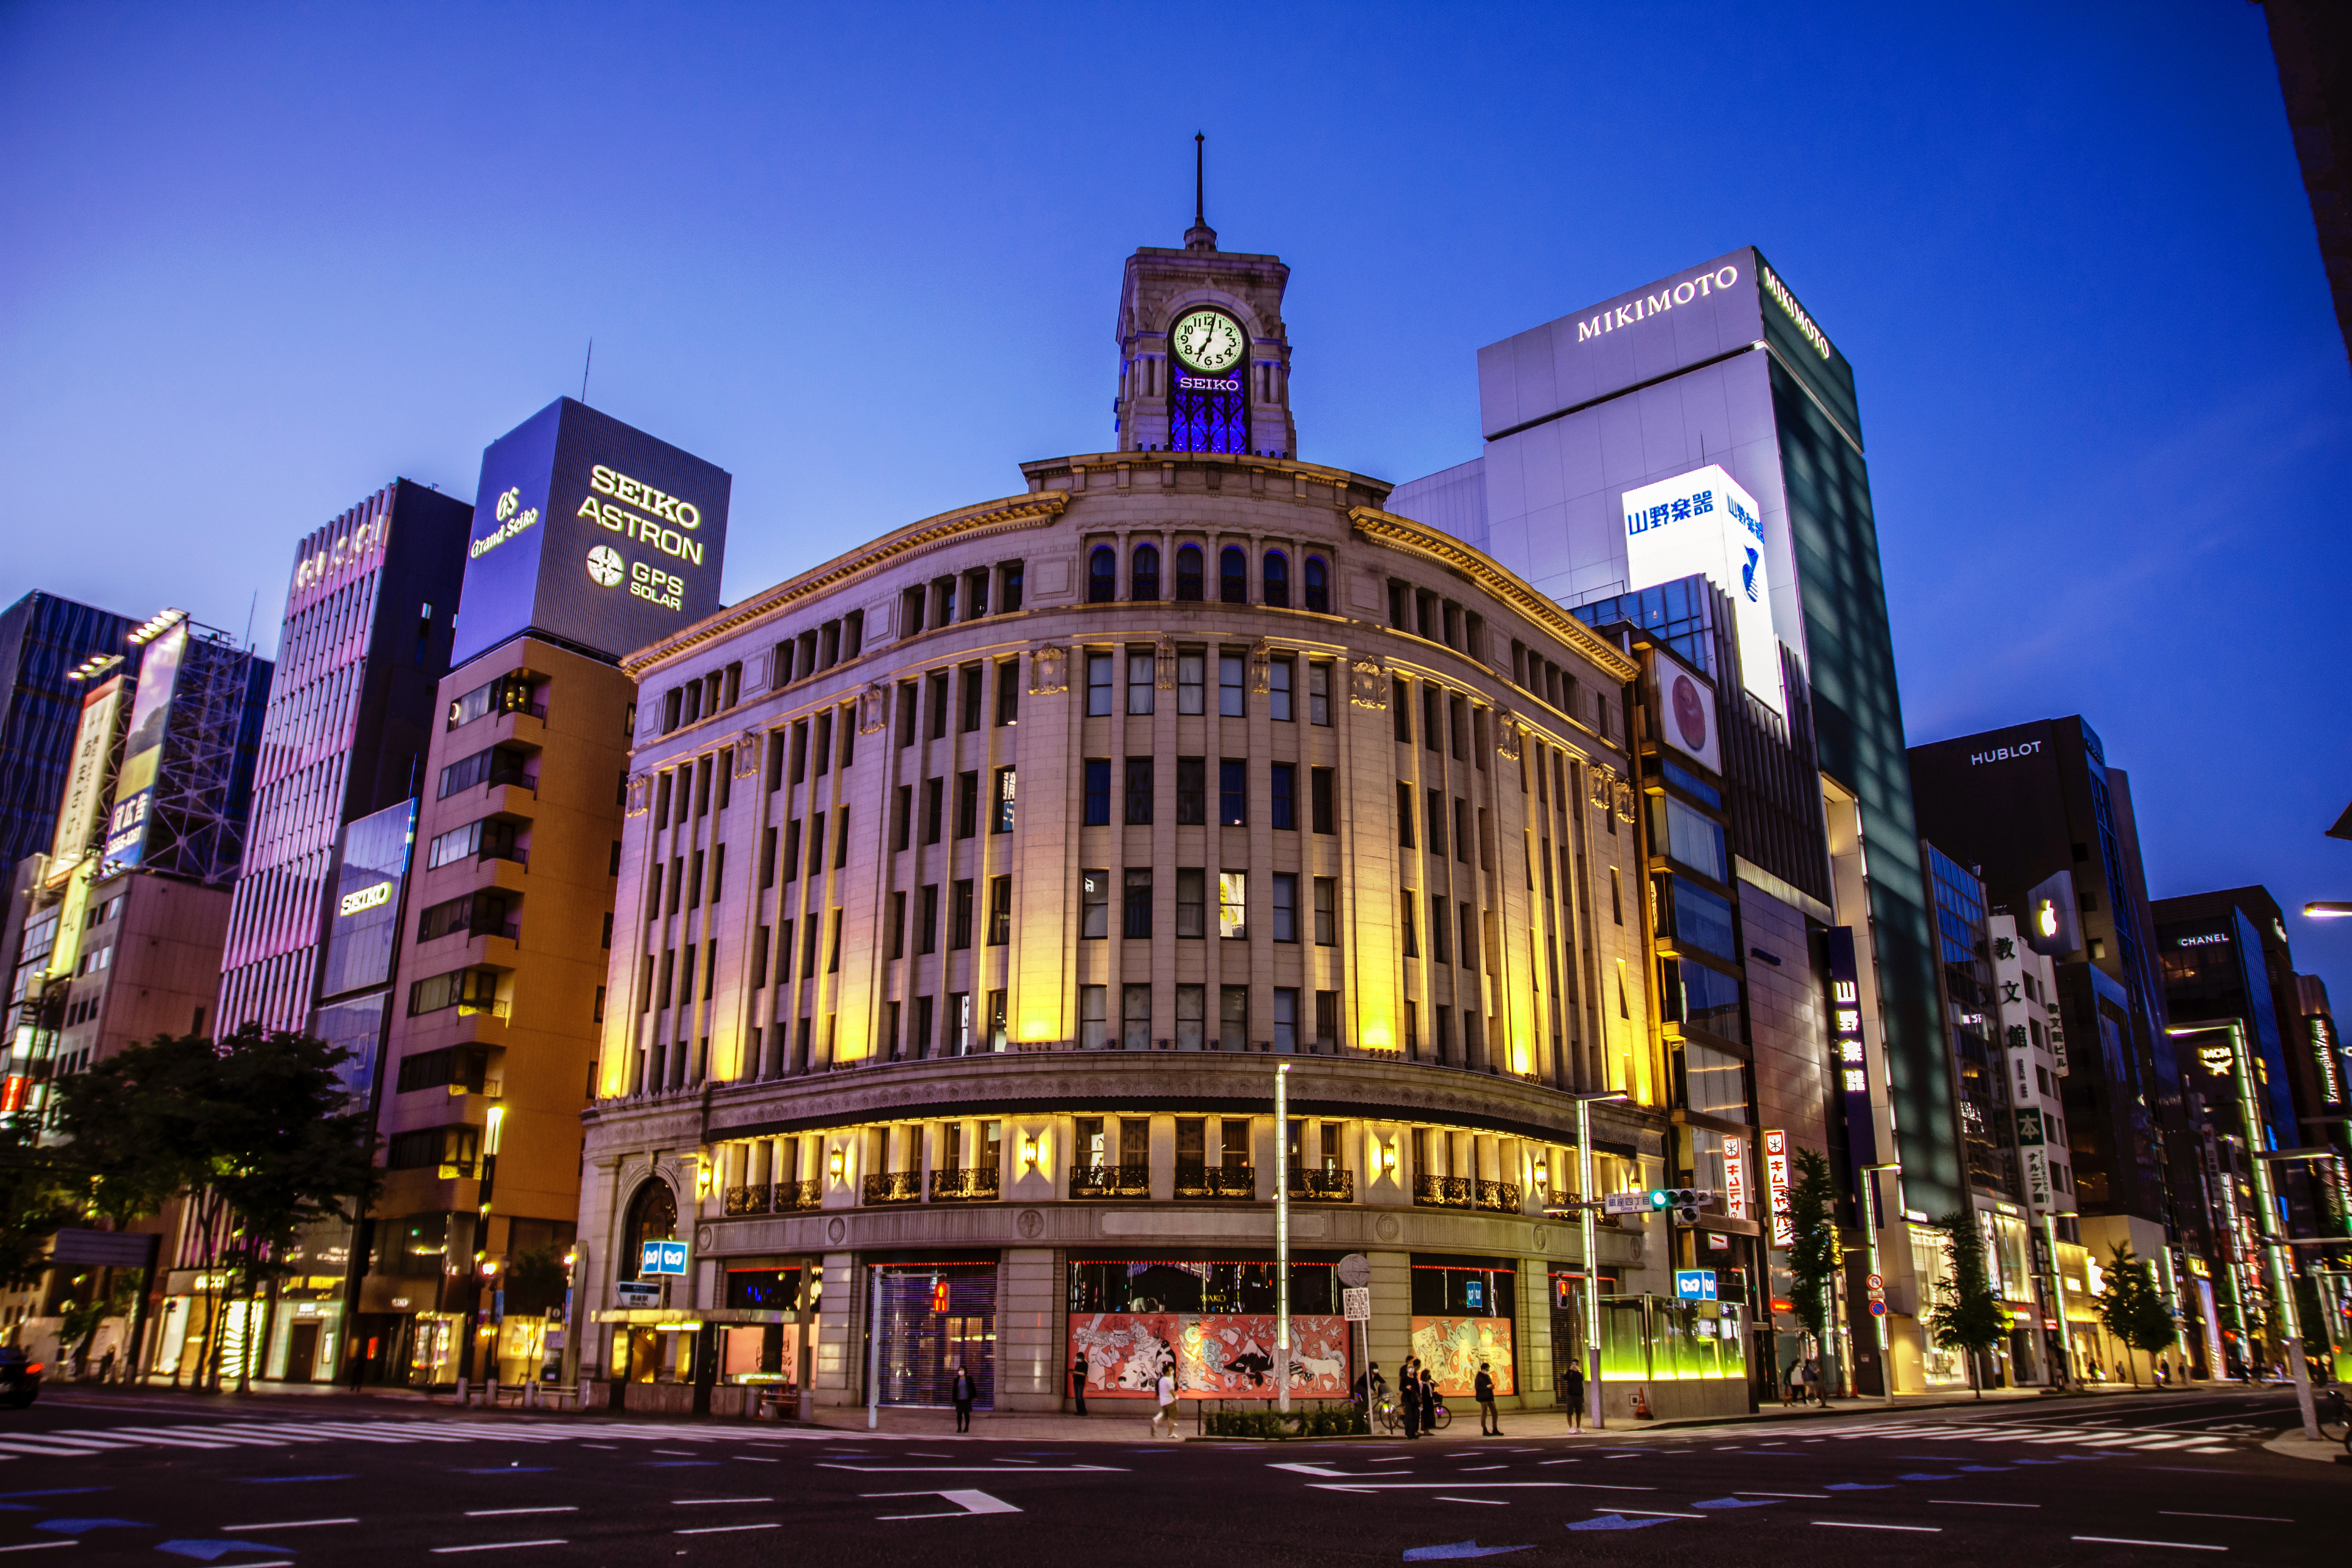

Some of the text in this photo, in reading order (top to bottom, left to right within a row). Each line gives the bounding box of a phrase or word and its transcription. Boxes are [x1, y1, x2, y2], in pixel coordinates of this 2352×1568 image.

[1578, 266, 1738, 342] MIKIMOTO
[1765, 267, 1830, 359] MIKIMOTO
[1194, 318, 1201, 327] 11
[1204, 316, 1214, 325] 12
[1219, 319, 1221, 328] 1
[1184, 325, 1193, 334] 10
[1225, 327, 1232, 336] 2
[1180, 335, 1188, 344] 9
[1229, 338, 1236, 347] 3
[1184, 345, 1192, 354] 8
[1224, 347, 1233, 357] 4
[1204, 356, 1212, 365] 6
[1216, 354, 1223, 363] 5
[1180, 377, 1239, 391] SEIKO
[496, 486, 520, 521] GS
[591, 465, 700, 529] SEIKO
[1628, 490, 1713, 535] 山野楽器
[471, 508, 538, 559] Grand Seiko
[577, 496, 702, 565] ASTRON
[632, 562, 684, 596] GPS
[630, 581, 681, 611] SOLAR
[1971, 741, 2041, 765] HUBLOT
[340, 882, 390, 916] SEIKO
[2180, 933, 2229, 947] CHANEL
[1995, 936, 2027, 1048] 教文館
[2203, 1047, 2231, 1059] MCM
[2019, 1114, 2040, 1139] 本
[1609, 1197, 1650, 1206] 銀座四丁目
[1771, 1161, 1789, 1240] キムラヤパン
